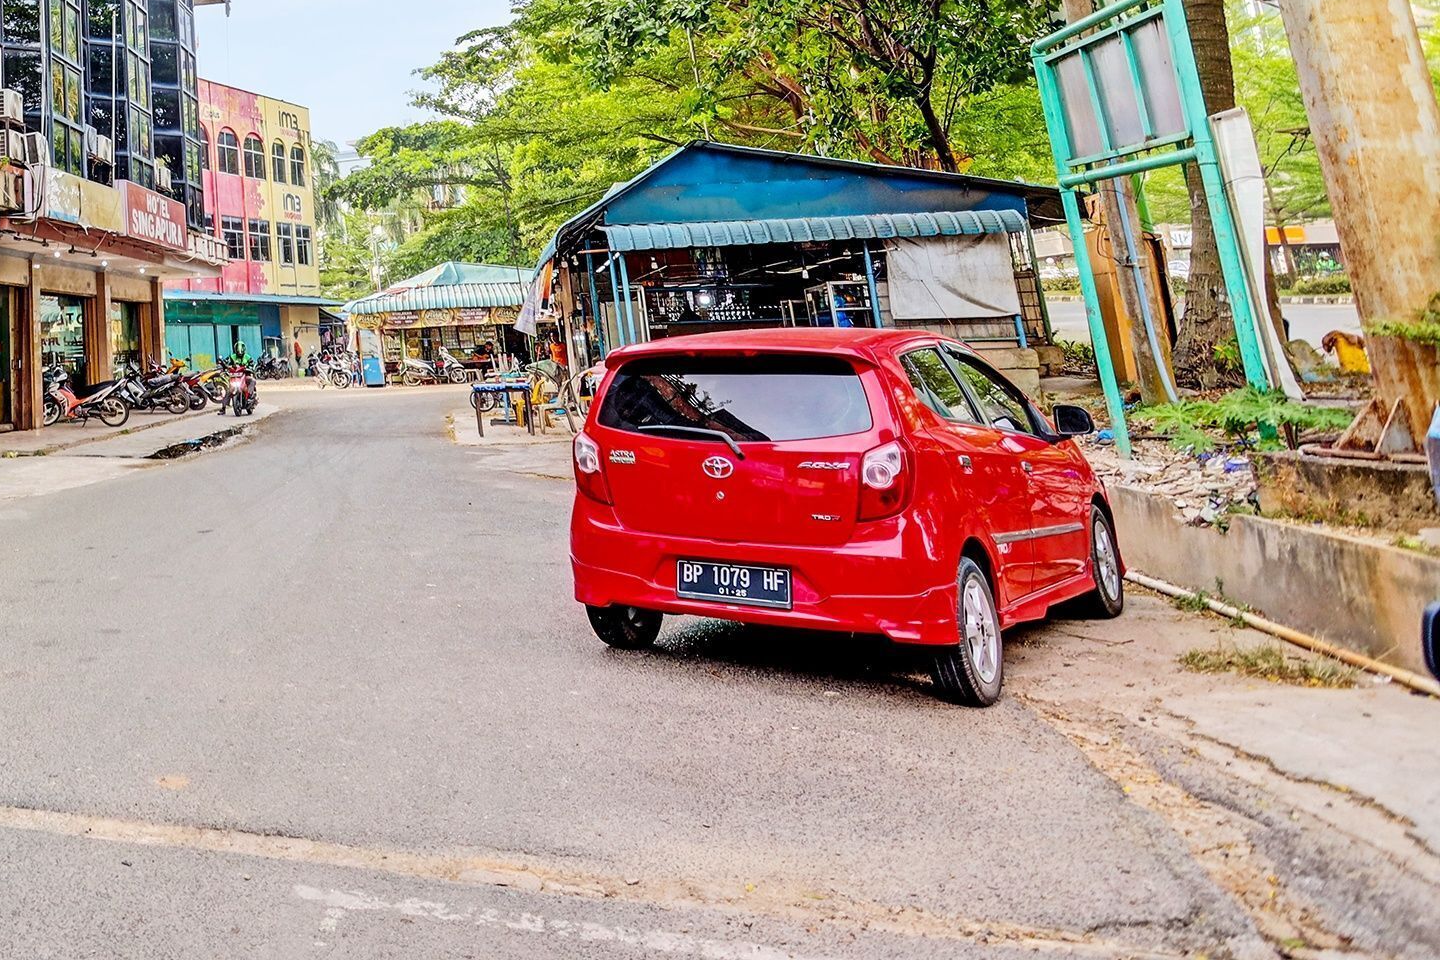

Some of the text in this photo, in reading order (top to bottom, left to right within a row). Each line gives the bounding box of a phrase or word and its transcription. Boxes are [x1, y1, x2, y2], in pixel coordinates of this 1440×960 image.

[132, 208, 184, 248] SINGAPURA
[683, 563, 784, 591] BP 1079 HF
